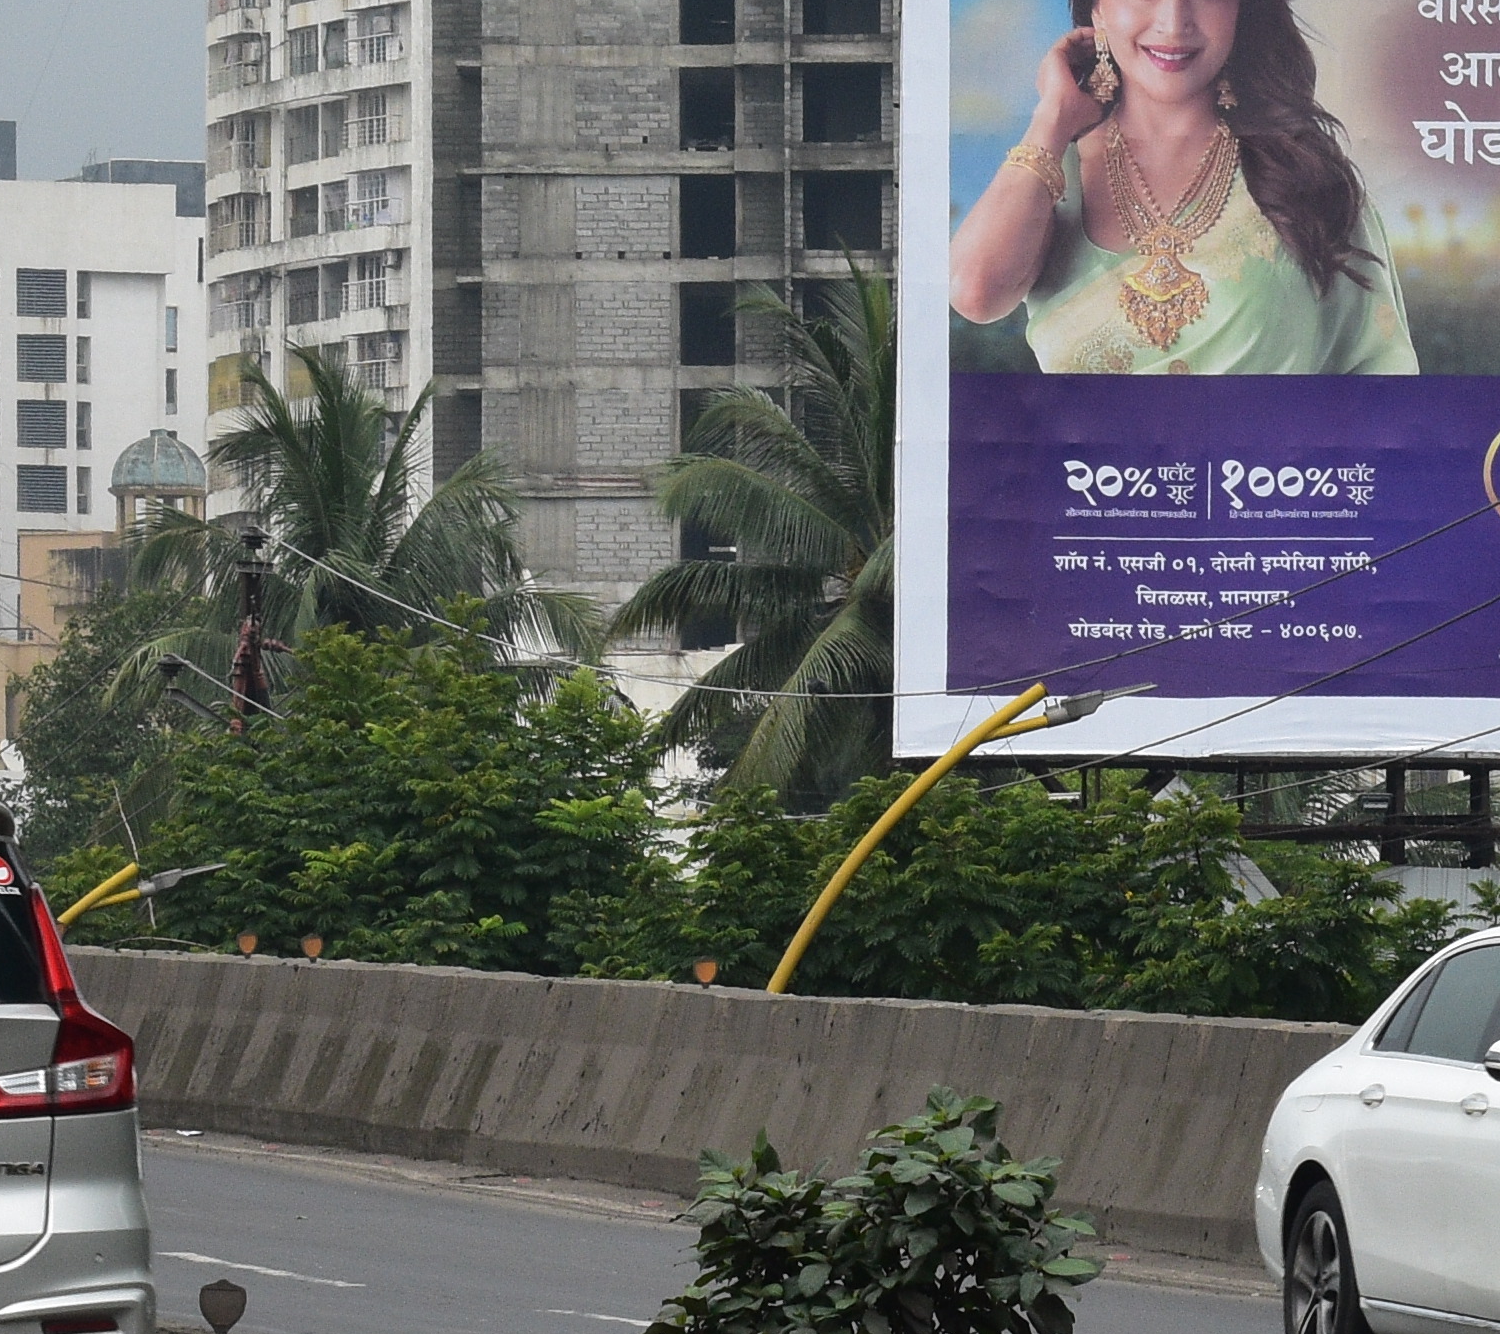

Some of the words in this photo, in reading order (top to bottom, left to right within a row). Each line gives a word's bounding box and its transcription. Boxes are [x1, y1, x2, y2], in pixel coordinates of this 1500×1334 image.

[1063, 459, 1158, 506] २०%
[1166, 483, 1197, 505] सूट
[1220, 459, 1339, 510] १००%
[1347, 485, 1375, 506] सूट
[1053, 551, 1089, 572] शॉप
[1092, 550, 1112, 571] नं.
[1117, 552, 1166, 575] एसजी
[1210, 551, 1256, 574] दोस्ती
[1260, 550, 1325, 575] इम्पेरिया
[1135, 584, 1214, 609] चितळसर,
[1067, 617, 1133, 641] घोडबंदर
[1279, 623, 1363, 642] ४००६०७.
